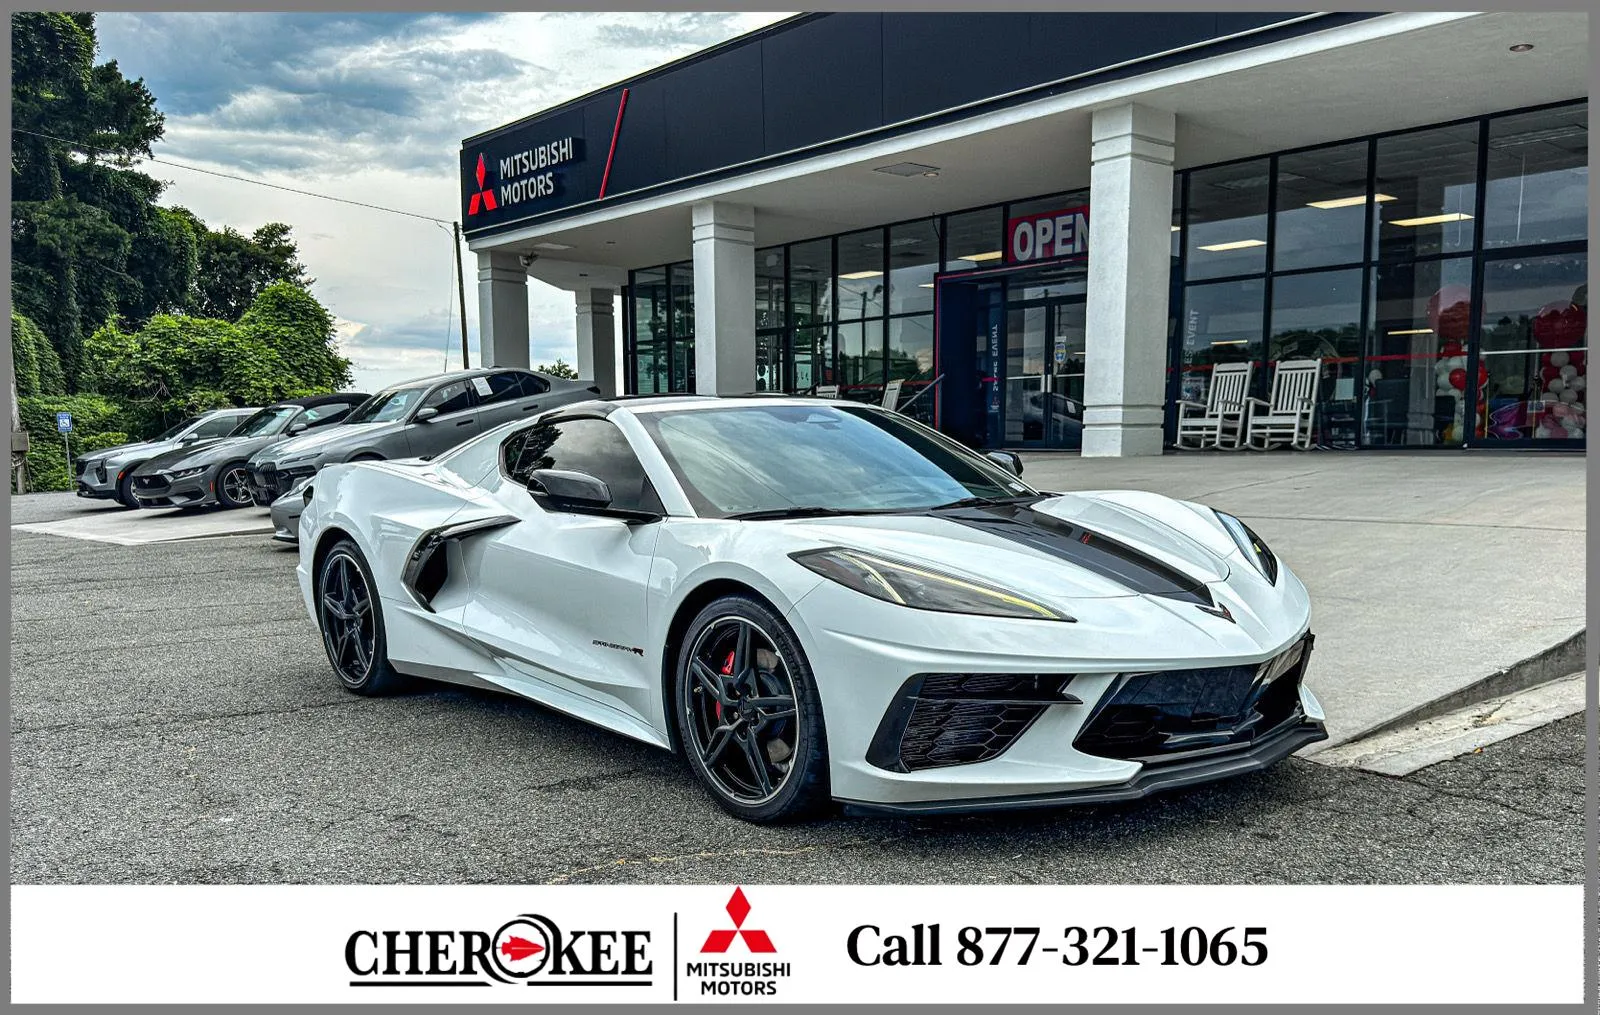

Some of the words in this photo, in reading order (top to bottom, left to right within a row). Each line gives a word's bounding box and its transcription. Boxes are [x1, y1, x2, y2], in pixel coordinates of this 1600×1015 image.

[500, 137, 573, 180] MITSUBISHI
[501, 172, 554, 207] MOTORS
[1013, 212, 1090, 262] OPEN
[1186, 308, 1200, 346] EVENT
